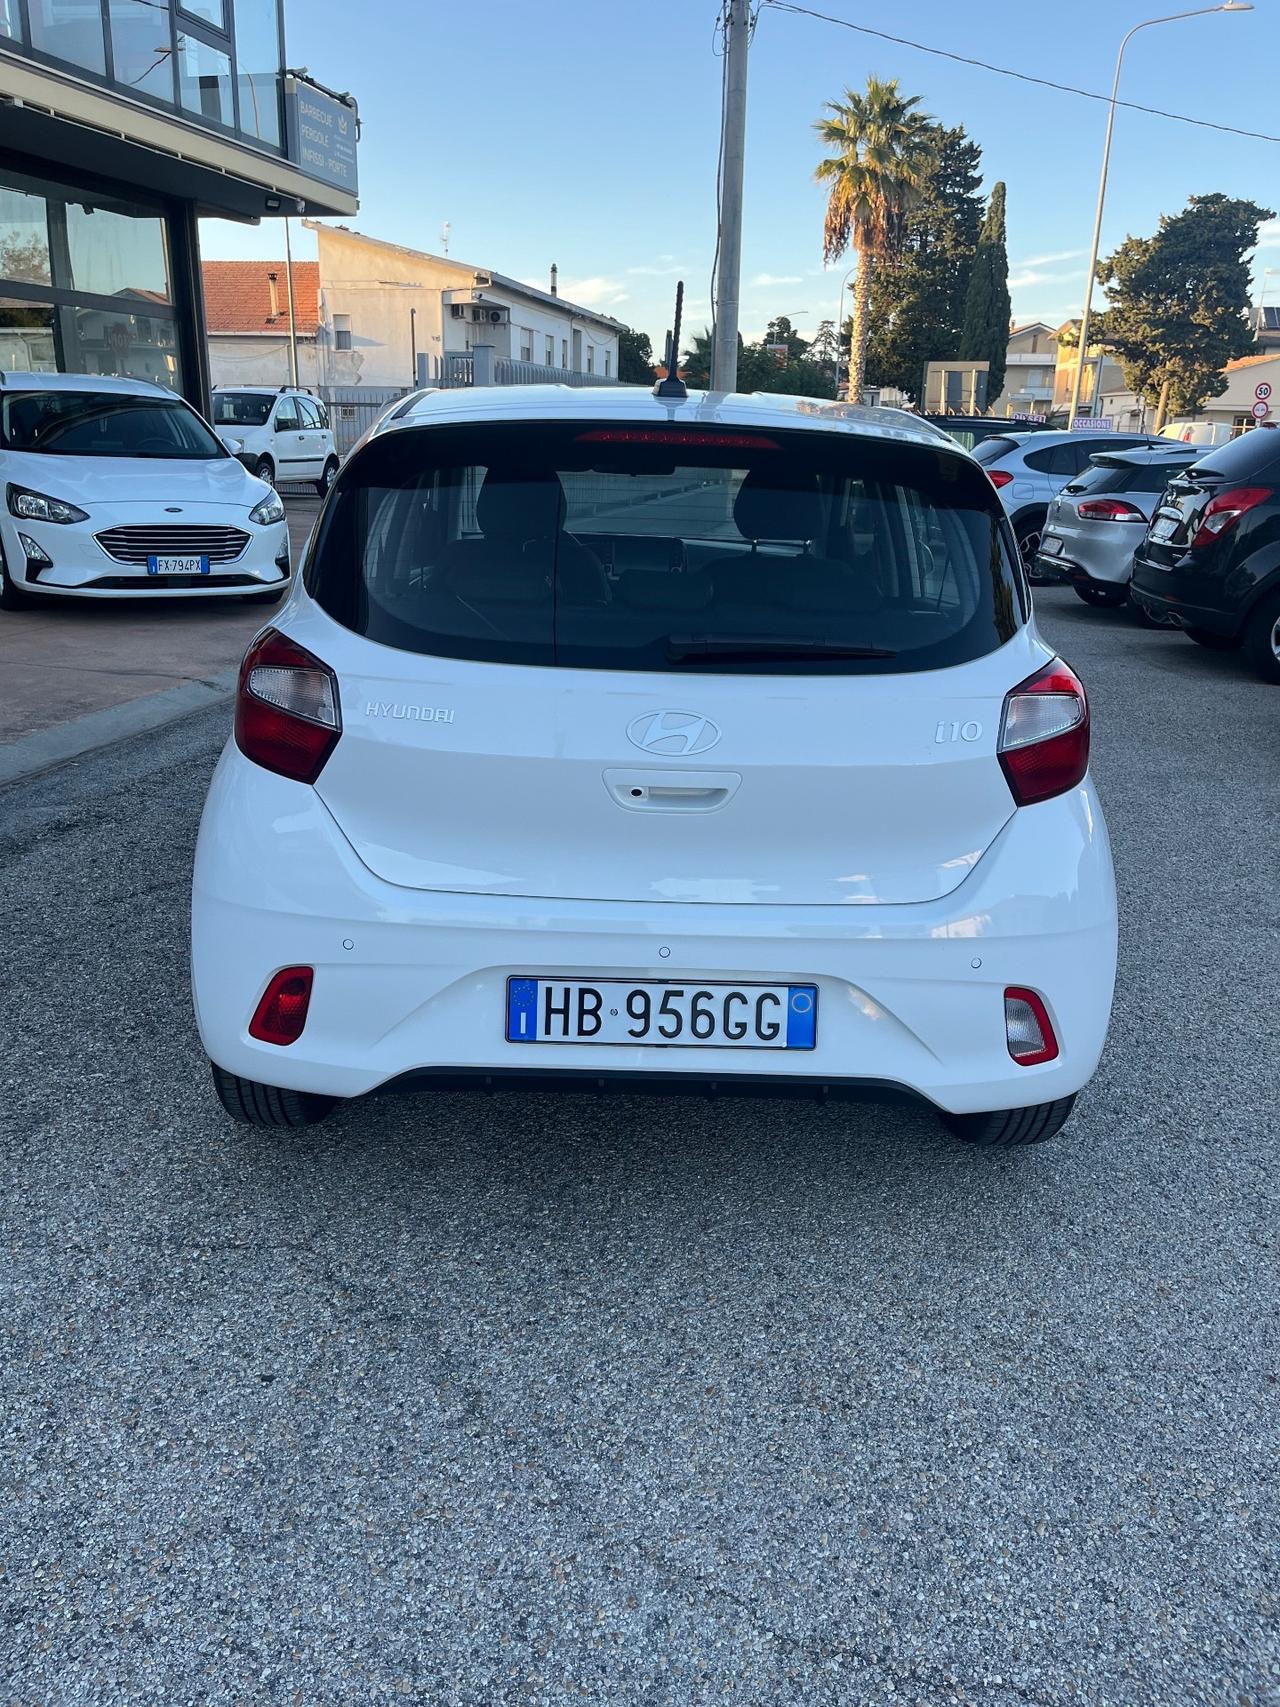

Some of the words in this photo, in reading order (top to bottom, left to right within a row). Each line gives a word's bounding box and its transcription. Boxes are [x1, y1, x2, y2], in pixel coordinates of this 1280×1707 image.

[300, 101, 333, 127] BARBECUE
[301, 124, 329, 148] PERGOLE
[303, 147, 324, 167] INFISSI
[328, 158, 347, 177] PORTE
[1258, 386, 1269, 396] 50
[1073, 419, 1111, 429] OCCASIONE
[365, 701, 455, 724] HYUNDAI
[935, 720, 983, 744] i10
